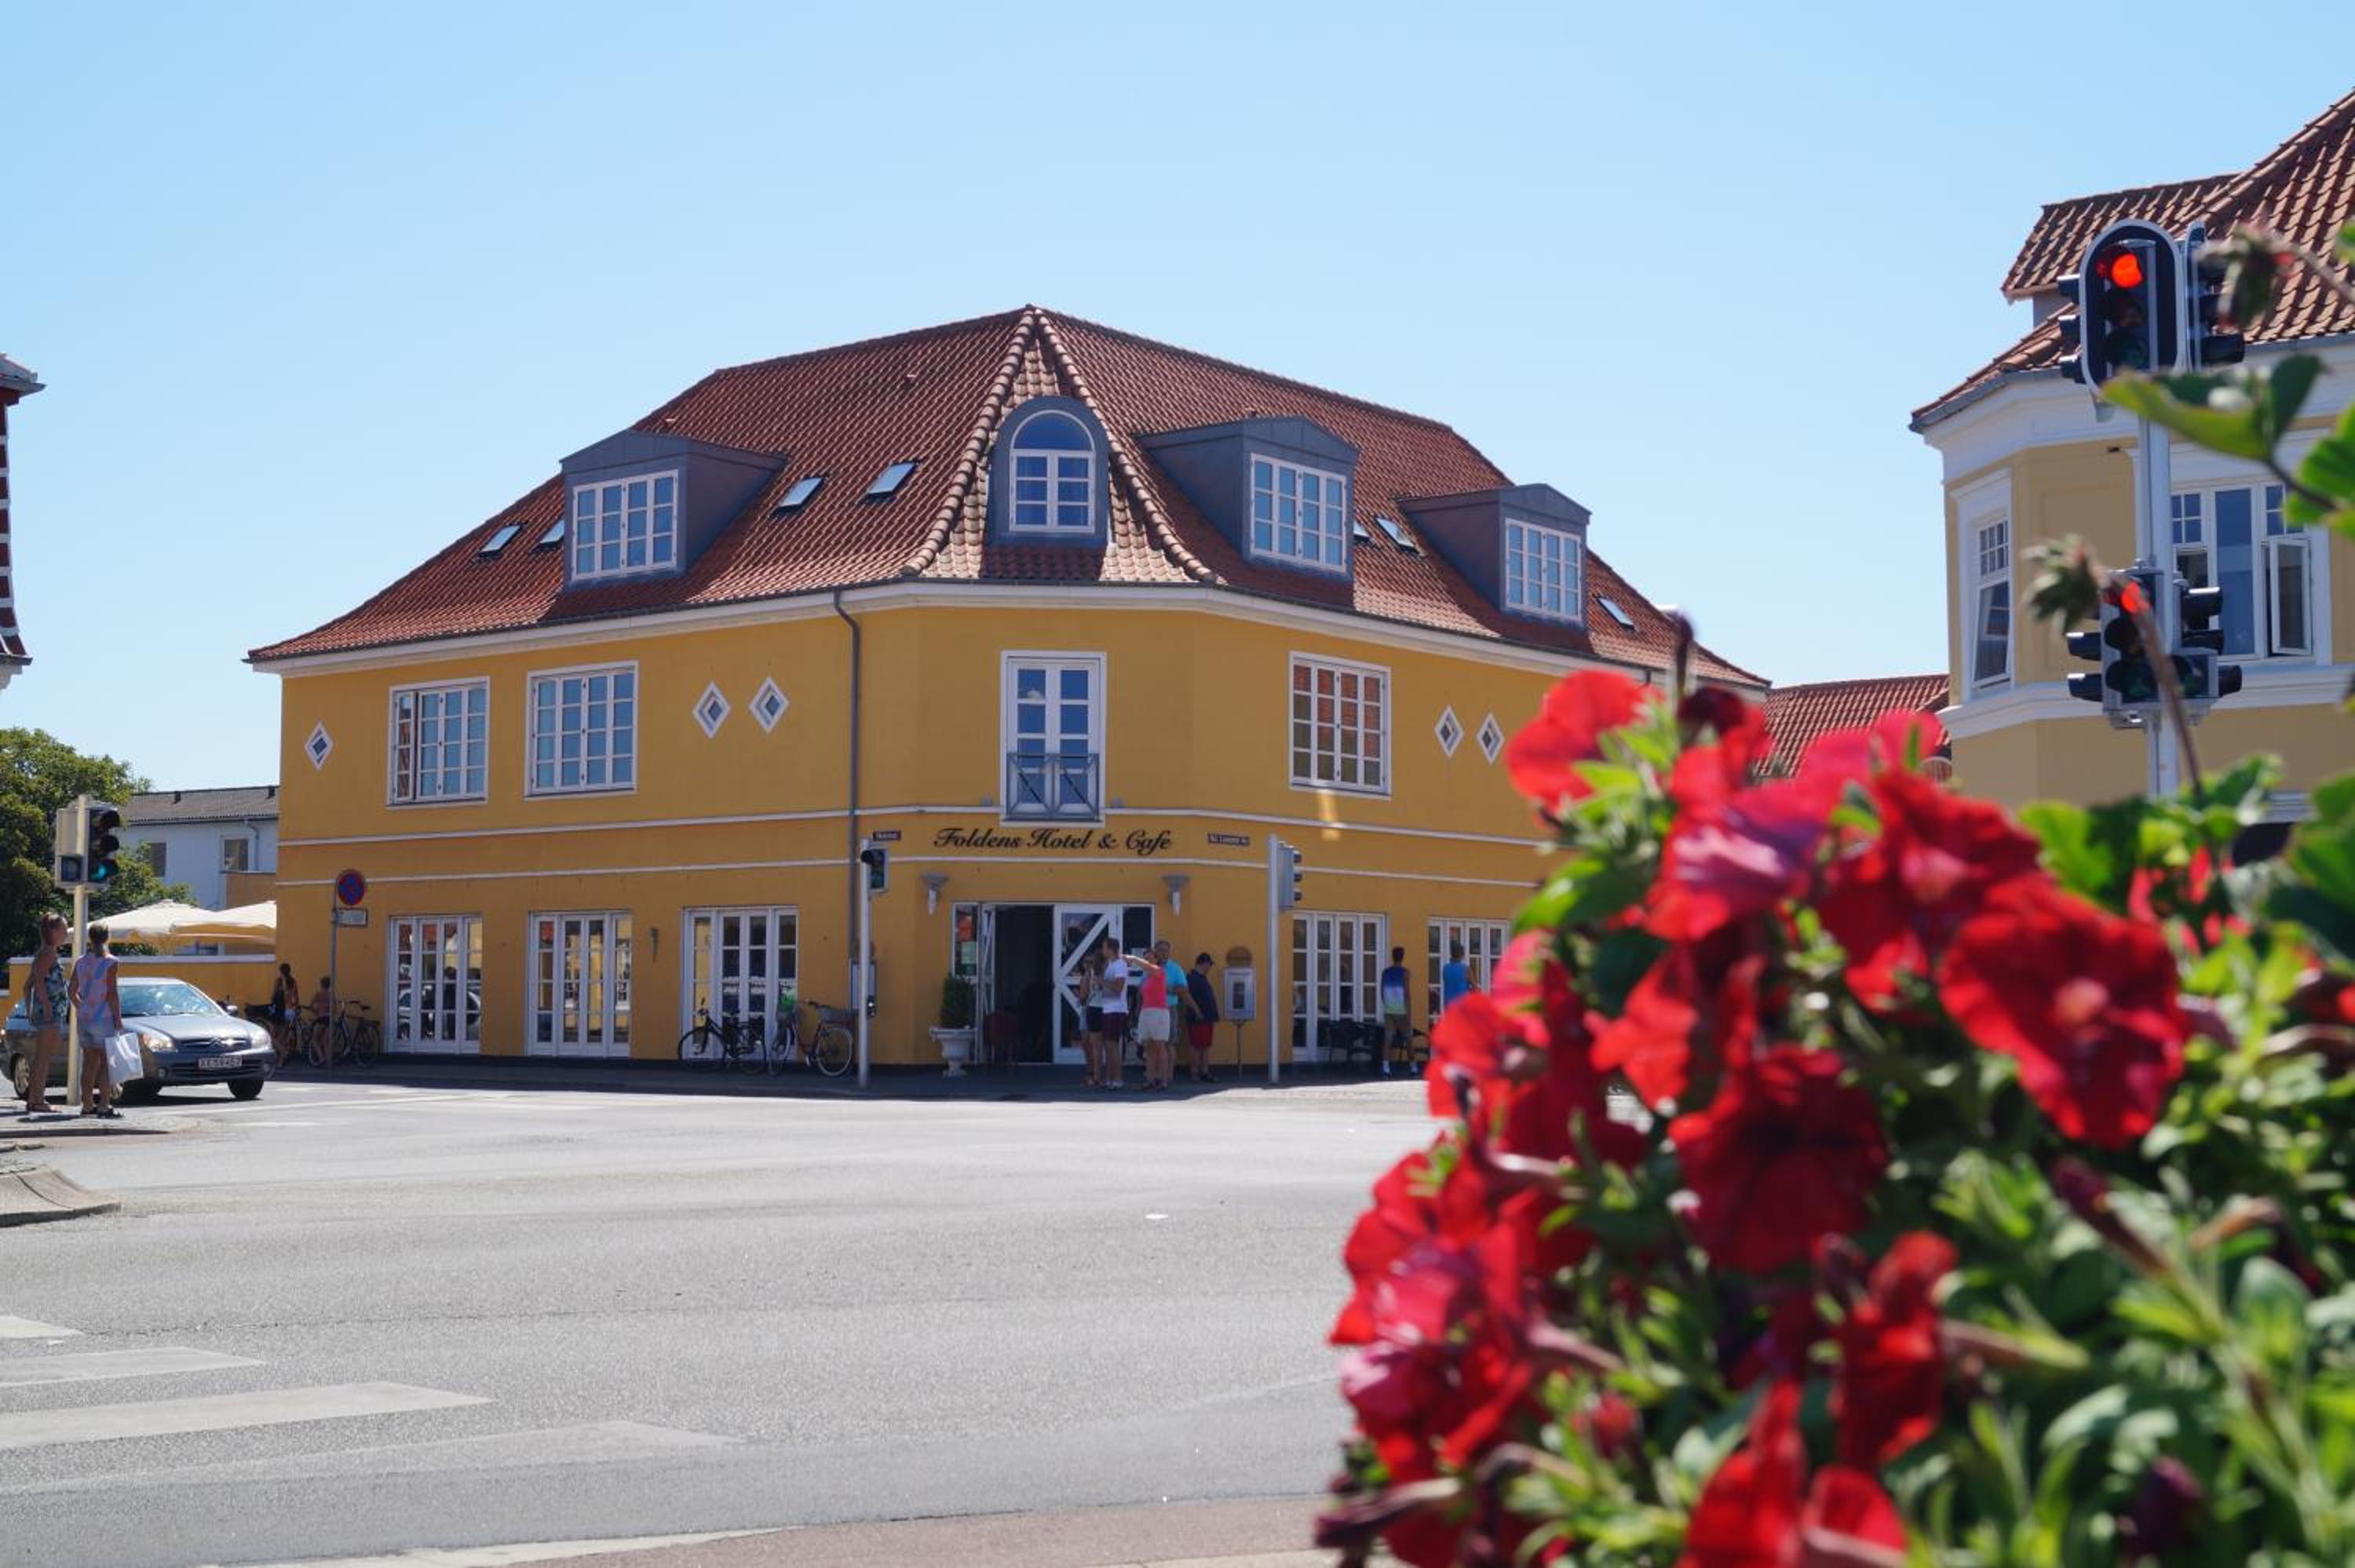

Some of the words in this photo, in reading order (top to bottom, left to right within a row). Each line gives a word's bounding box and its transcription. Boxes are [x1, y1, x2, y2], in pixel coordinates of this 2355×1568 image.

[933, 828, 1020, 848] Foldens
[1027, 828, 1094, 848] Hotel
[1097, 833, 1119, 849] &
